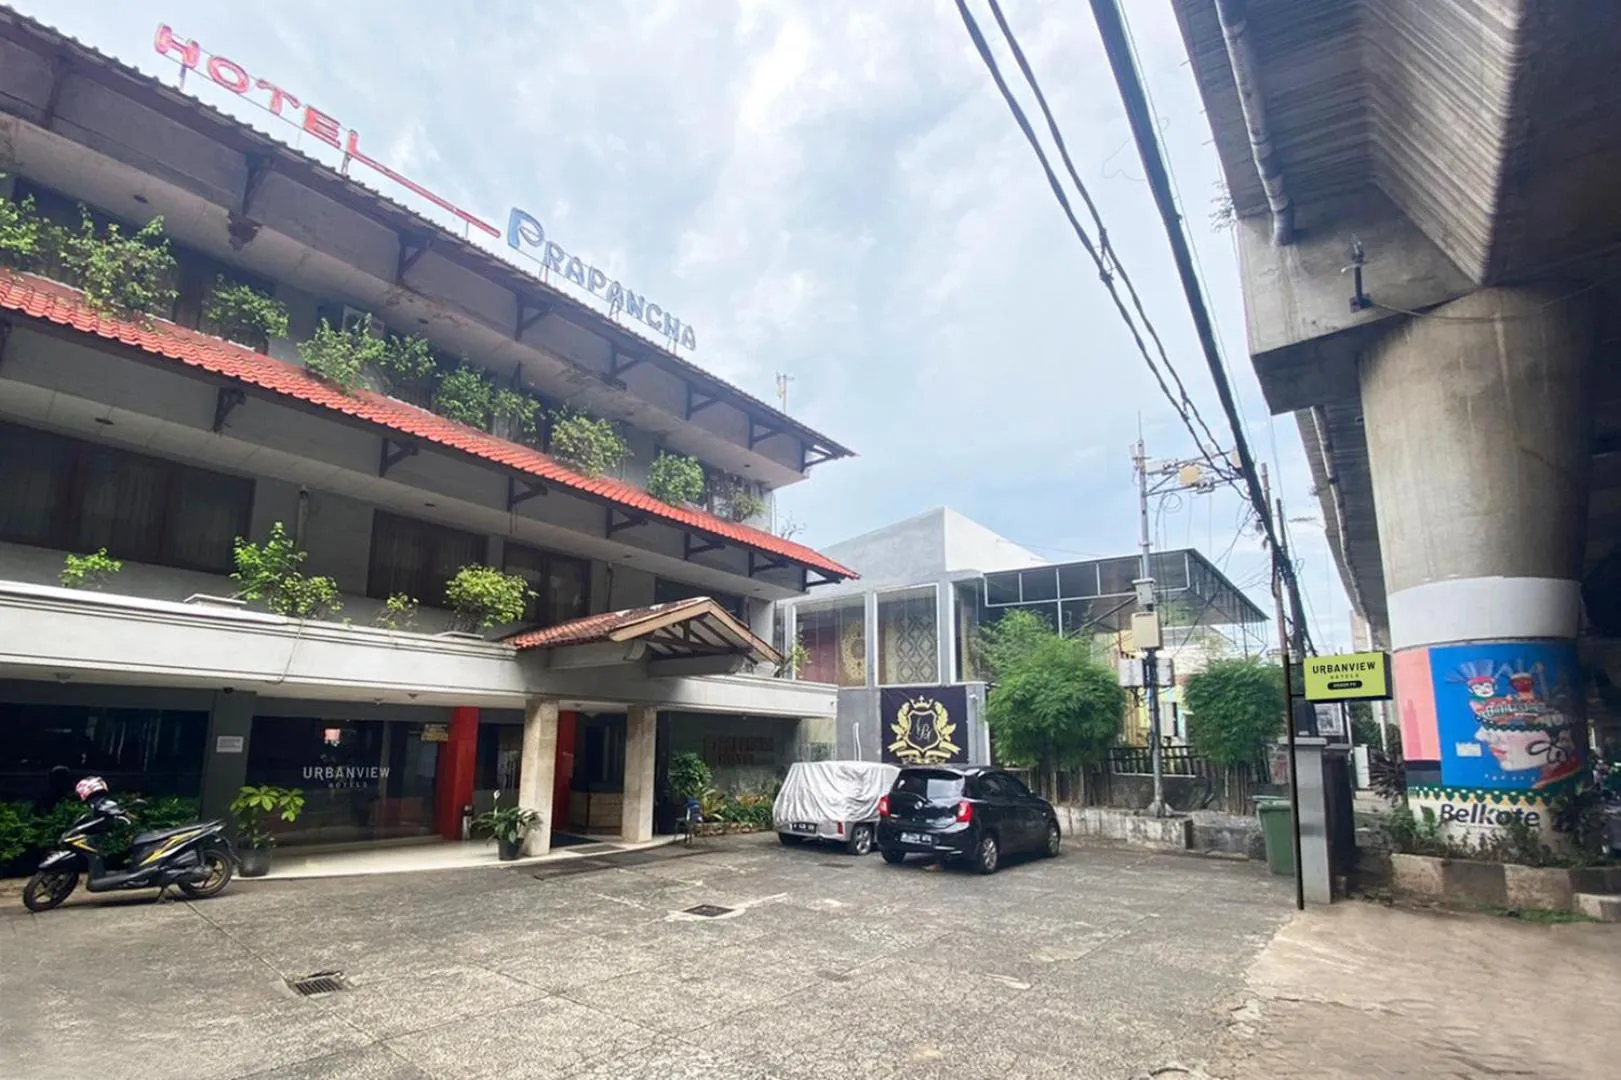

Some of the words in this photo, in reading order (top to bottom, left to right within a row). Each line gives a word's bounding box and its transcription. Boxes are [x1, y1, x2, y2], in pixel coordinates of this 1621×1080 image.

[507, 206, 697, 352] PRAPANCHA
[1312, 661, 1376, 675] URBANVIEW
[303, 766, 390, 780] URBANVIEW
[328, 781, 368, 789] HOTELS
